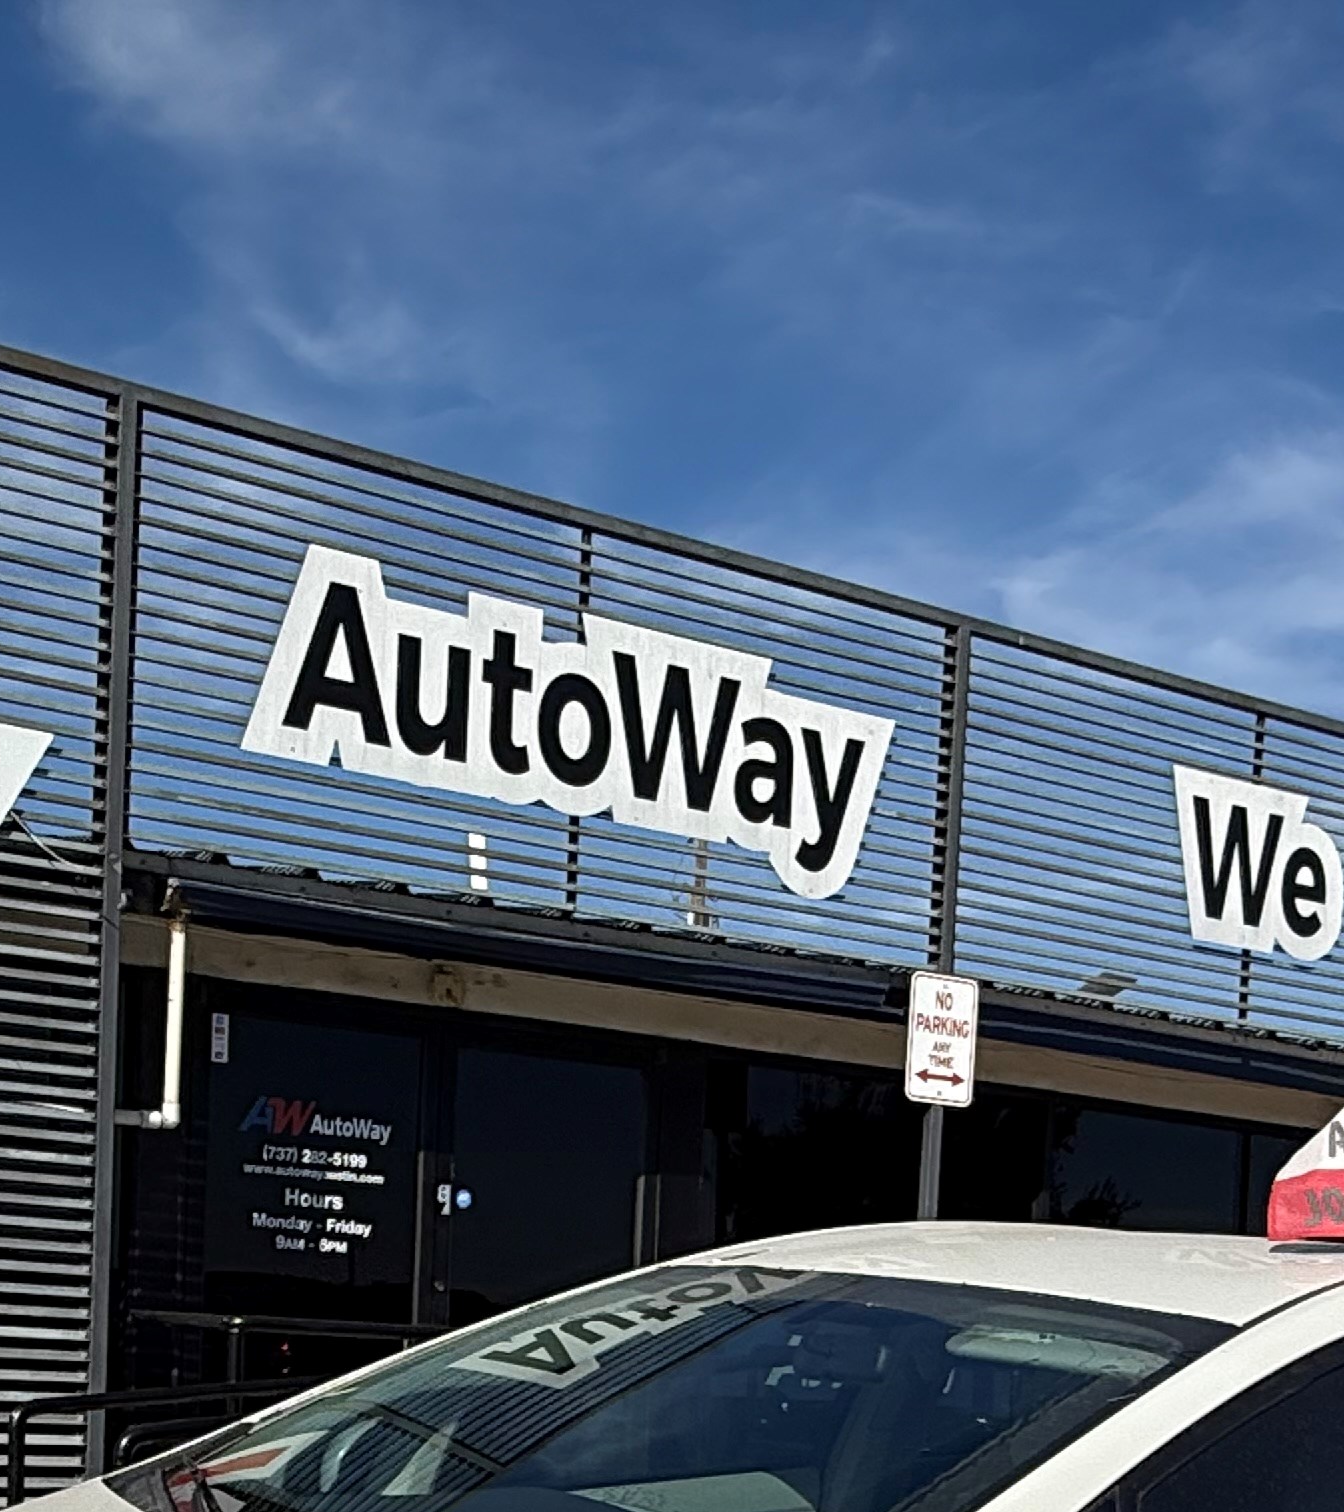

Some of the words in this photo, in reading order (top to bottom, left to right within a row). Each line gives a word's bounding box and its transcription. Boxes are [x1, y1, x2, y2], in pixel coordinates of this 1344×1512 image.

[282, 581, 865, 873] AutoWay
[1192, 796, 1327, 938] We
[935, 990, 954, 1012] NO
[916, 1013, 970, 1039] PARKING
[932, 1041, 952, 1054] ANY
[928, 1054, 954, 1070] TIME
[310, 1114, 391, 1145] AutoWay
[262, 1144, 298, 1164] (737)
[301, 1148, 368, 1169] 282-5199
[284, 1187, 344, 1211] Hours
[252, 1212, 313, 1234] Monday
[326, 1218, 373, 1238] Friday
[275, 1234, 306, 1251] 9AM
